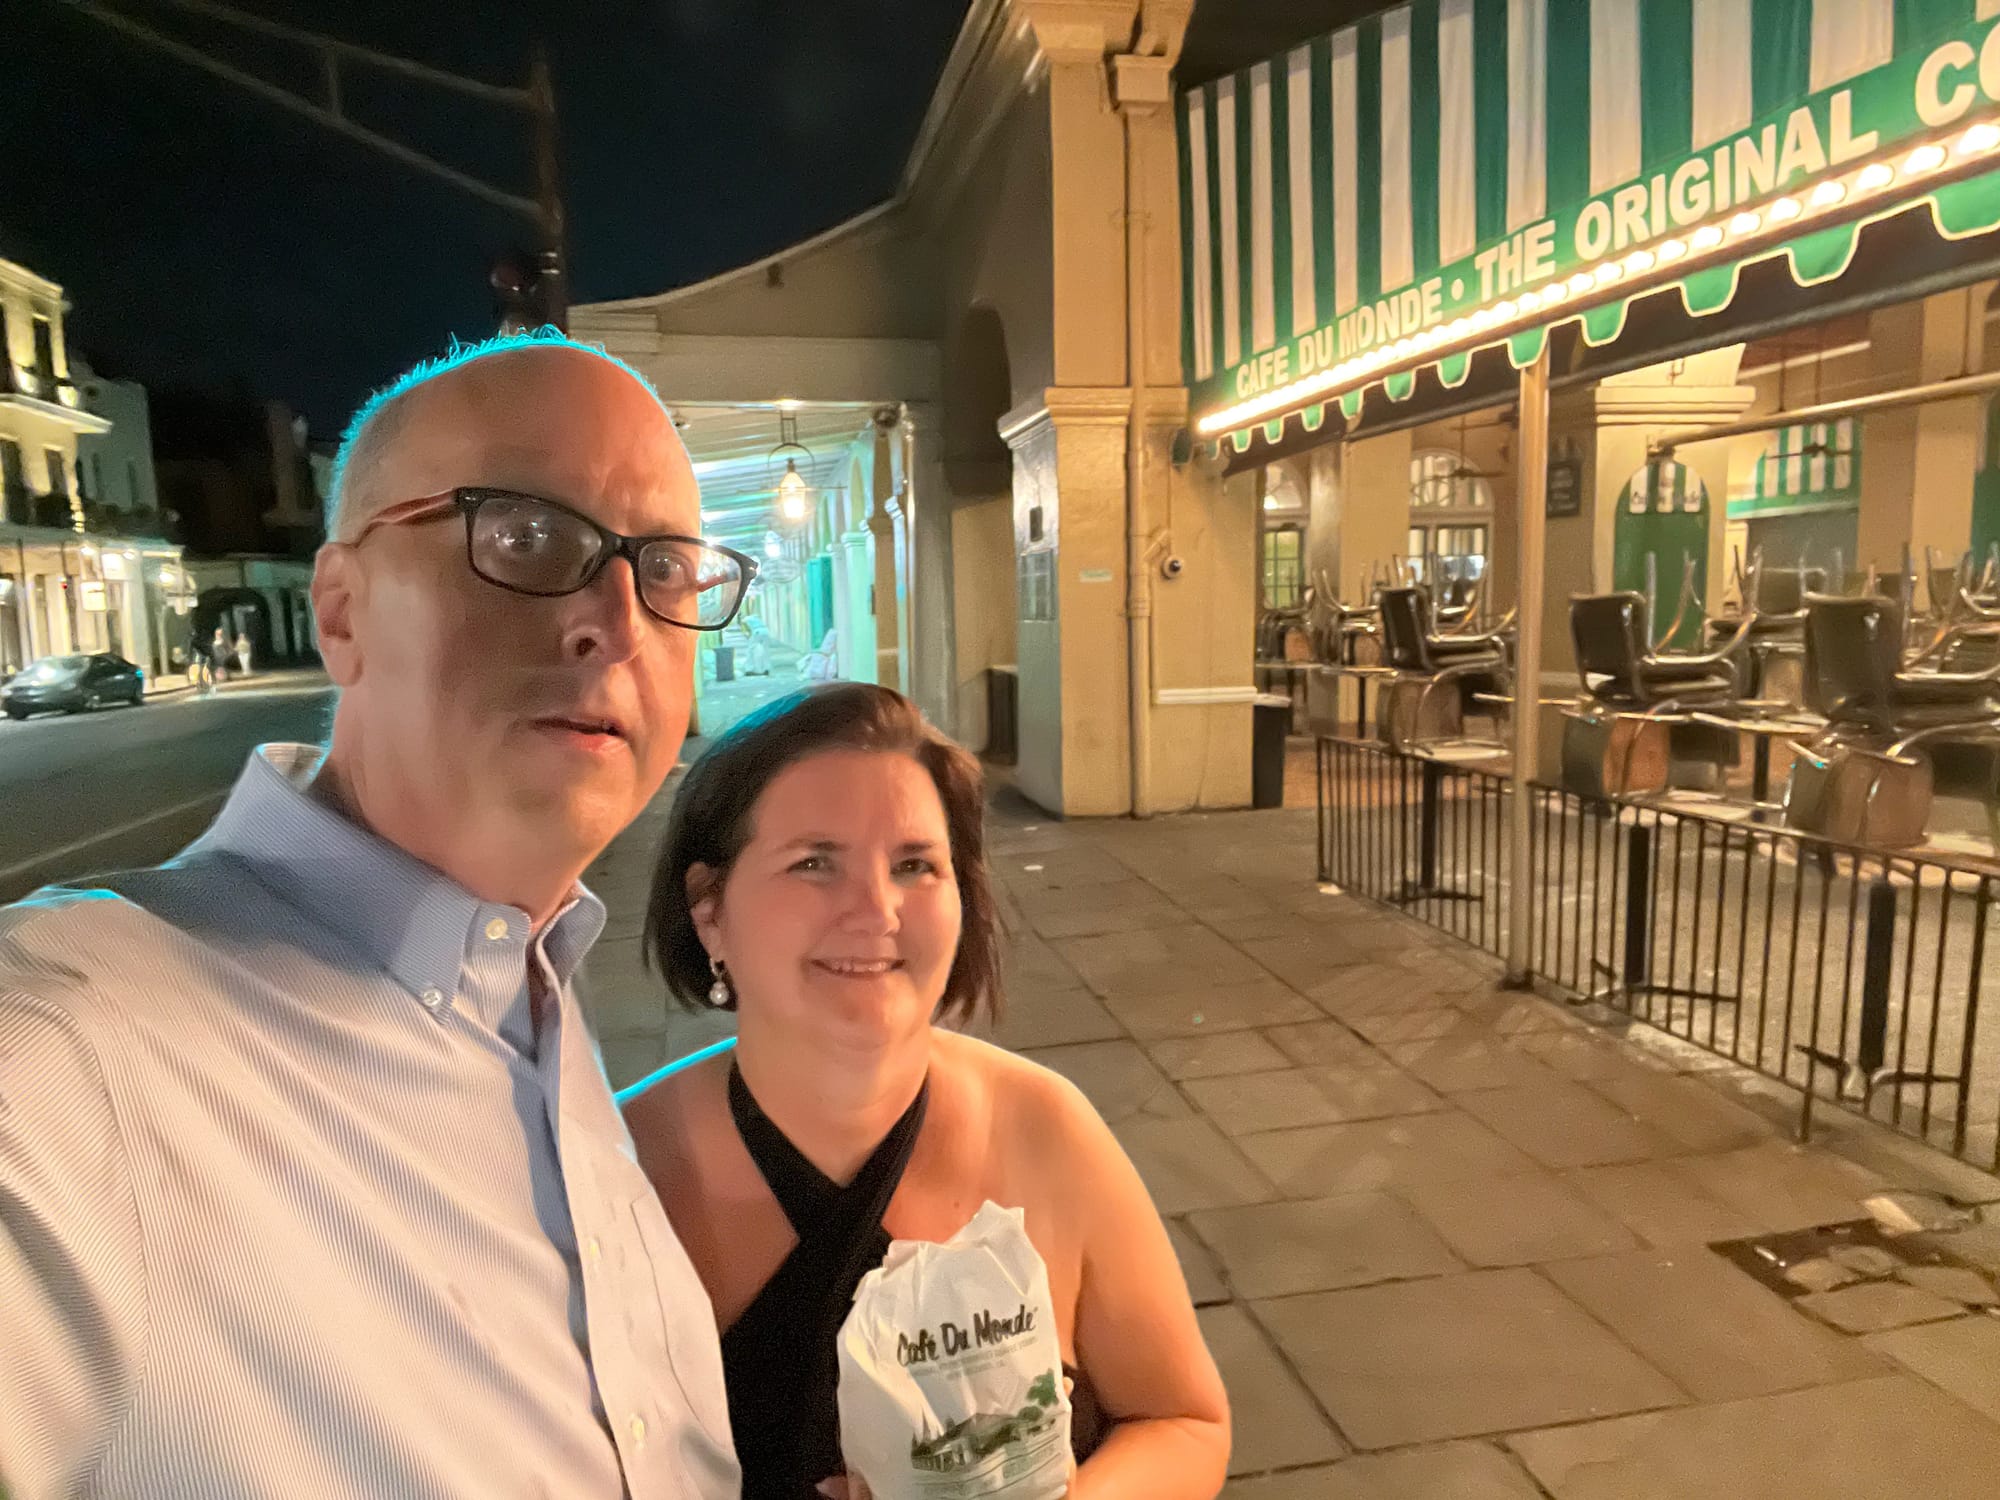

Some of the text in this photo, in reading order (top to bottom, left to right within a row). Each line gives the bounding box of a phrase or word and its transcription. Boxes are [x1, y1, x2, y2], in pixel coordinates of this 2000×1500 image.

[1236, 346, 1288, 399] CAFE
[1299, 326, 1333, 375] DU
[1338, 277, 1442, 359] MONDE
[1475, 220, 1556, 301] THE
[1575, 89, 1878, 261] ORIGINAL
[940, 1322, 970, 1356] Du
[973, 1304, 1036, 1348] Monde
